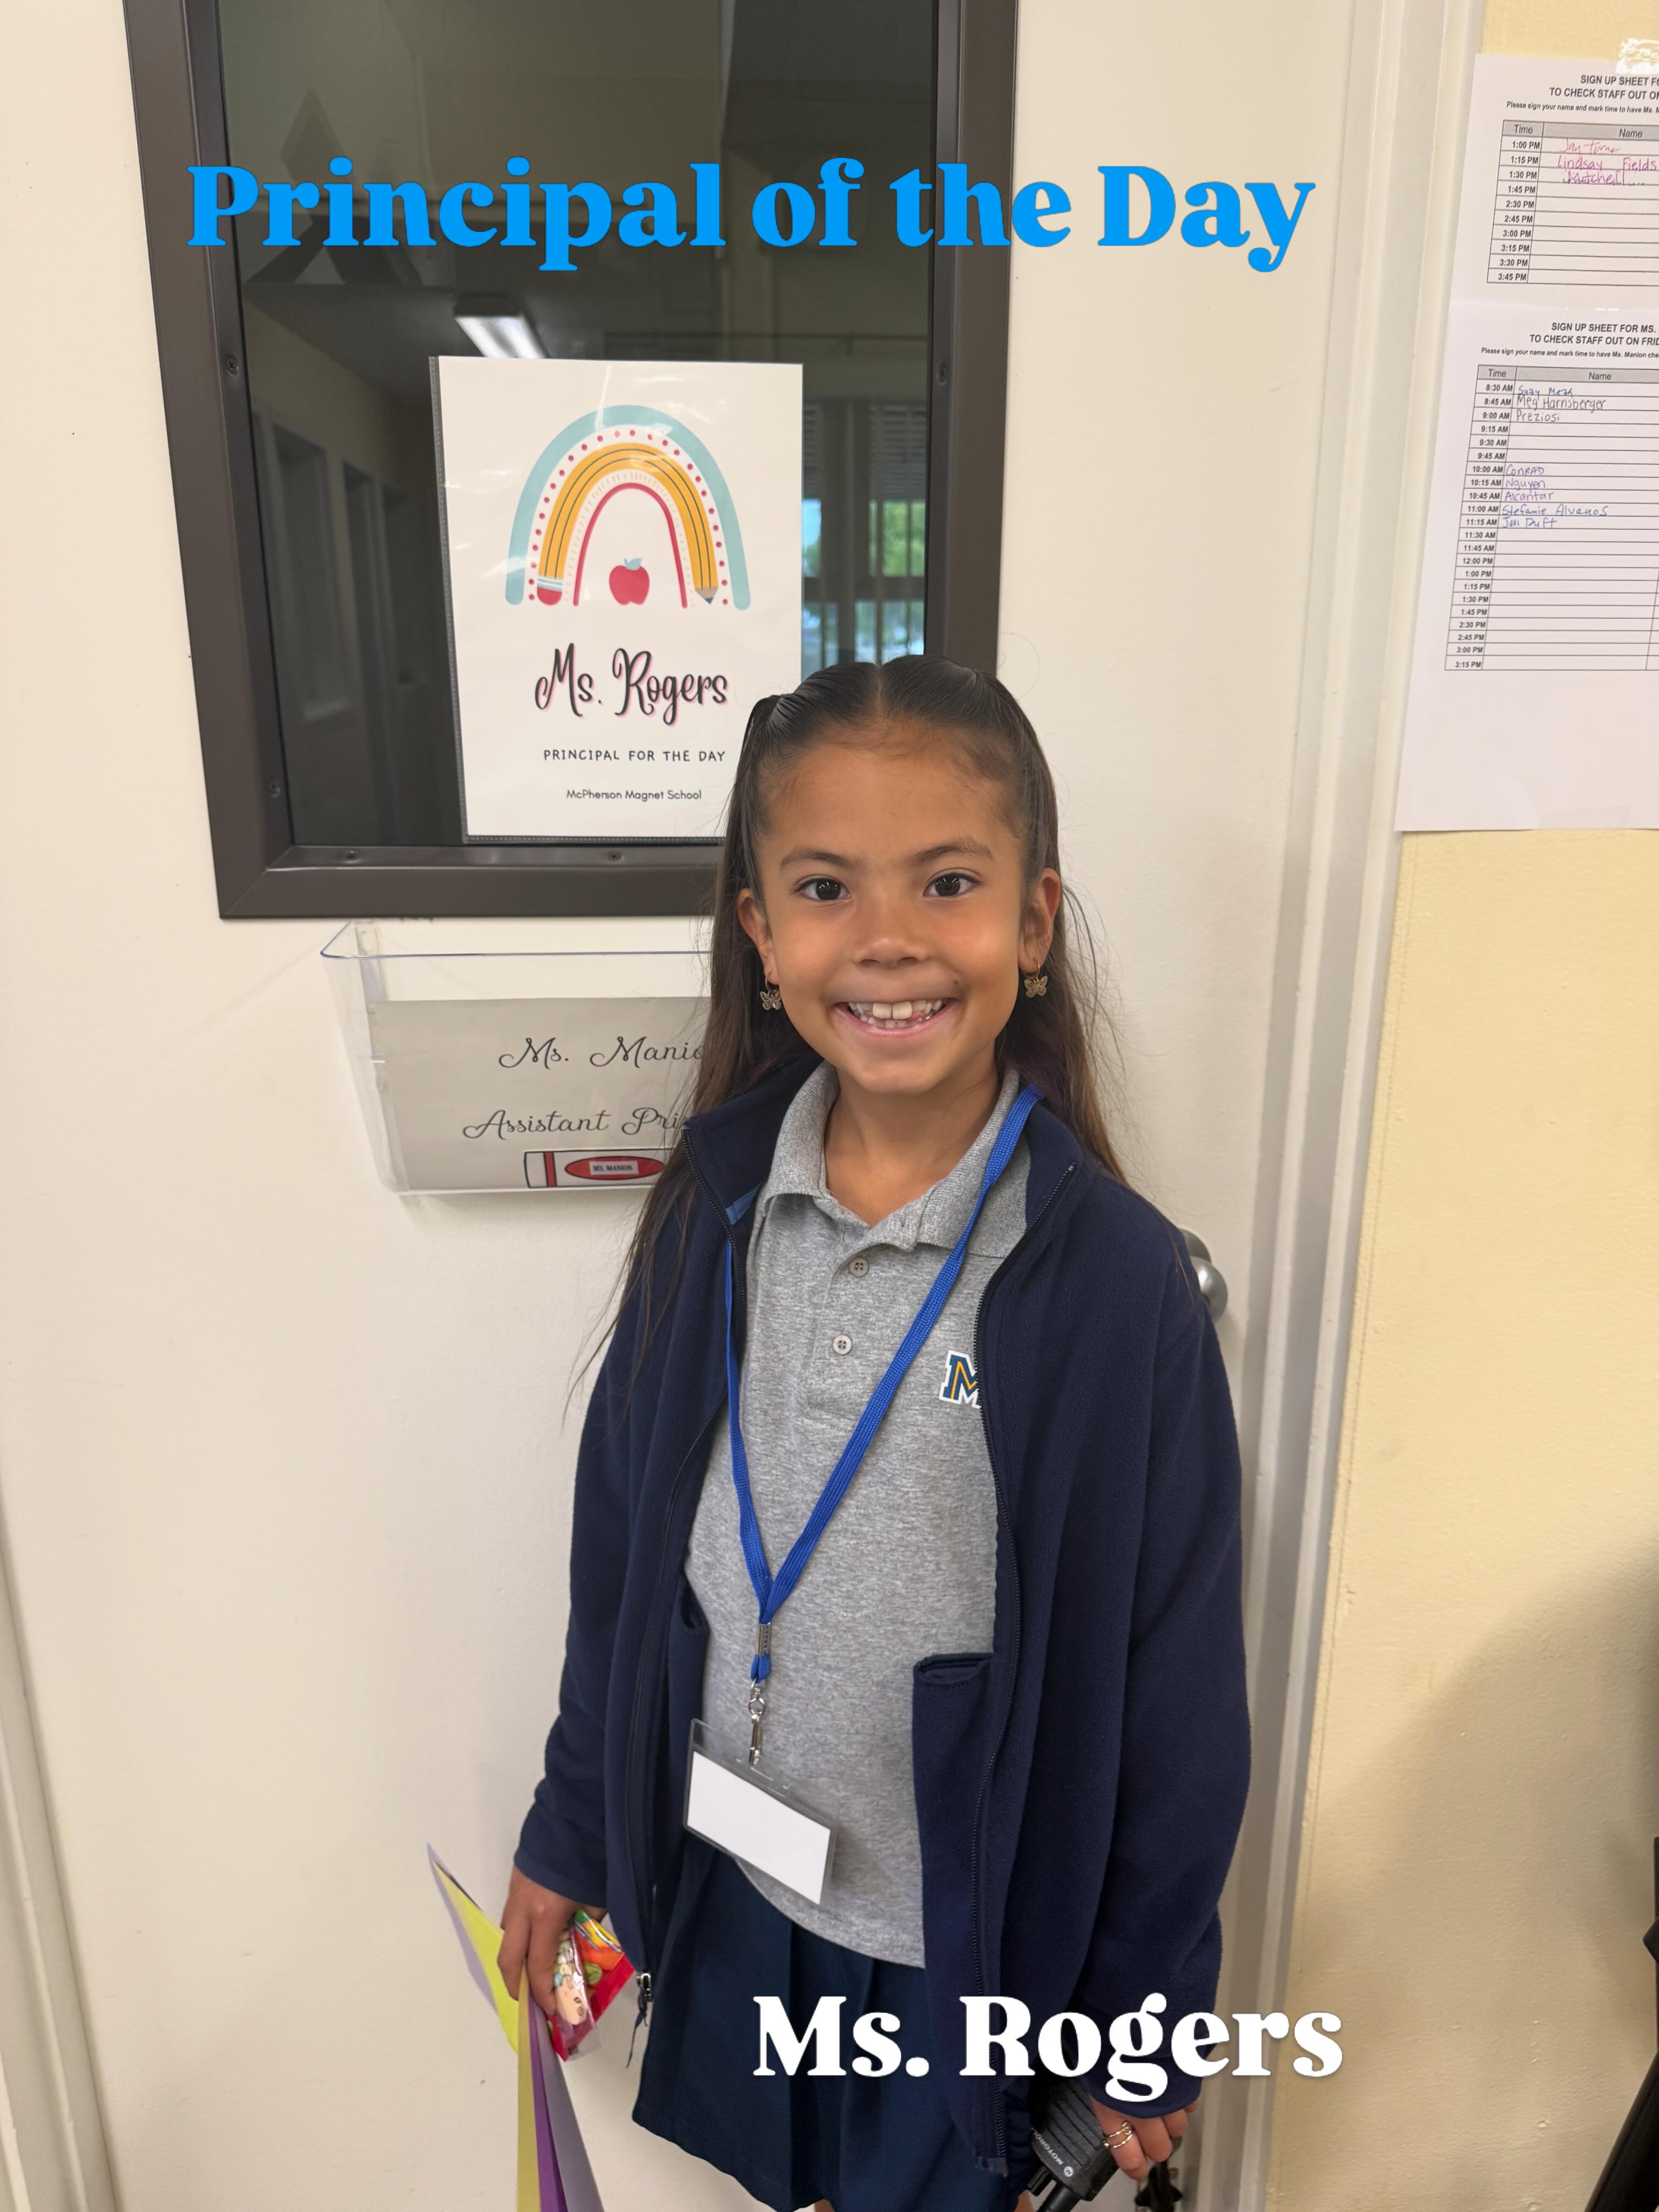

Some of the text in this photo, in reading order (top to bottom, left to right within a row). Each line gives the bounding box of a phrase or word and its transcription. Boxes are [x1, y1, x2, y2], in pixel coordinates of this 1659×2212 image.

[1581, 75, 1602, 84] SIGN
[1604, 76, 1616, 85] UP
[1619, 77, 1649, 86] SHEET
[1550, 87, 1561, 96] TO
[1564, 88, 1595, 97] CHECK
[1598, 90, 1625, 98] STAFF
[1628, 91, 1647, 99] OUT
[1528, 102, 1540, 110] sign
[1514, 125, 1642, 138] Time Name
[1527, 156, 1539, 164] PM
[1558, 155, 1657, 171] Lindsay Fields
[1524, 186, 1535, 194] PM
[1521, 215, 1533, 224] PM
[1500, 259, 1515, 267] 3:30
[1515, 273, 1527, 281] PM
[1552, 322, 1573, 331] SIGN
[1589, 324, 1617, 332] SHEET
[1620, 325, 1638, 333] FOR
[1544, 335, 1574, 343] CHECK
[1626, 337, 1639, 345] ON
[1488, 369, 1506, 377] Time
[1516, 395, 1537, 410] Meg
[1516, 409, 1560, 422] Preziosi
[1506, 478, 1546, 493] Nguyen
[1505, 491, 1554, 502] Alcantar
[535, 643, 729, 726] Ms. Rogers
[544, 750, 725, 761] PRINCIPAL FOR THE DAY
[567, 789, 702, 802] McPherson Magnet School
[498, 1036, 705, 1069] Ms. Manio
[462, 1110, 611, 1141] Assistant
